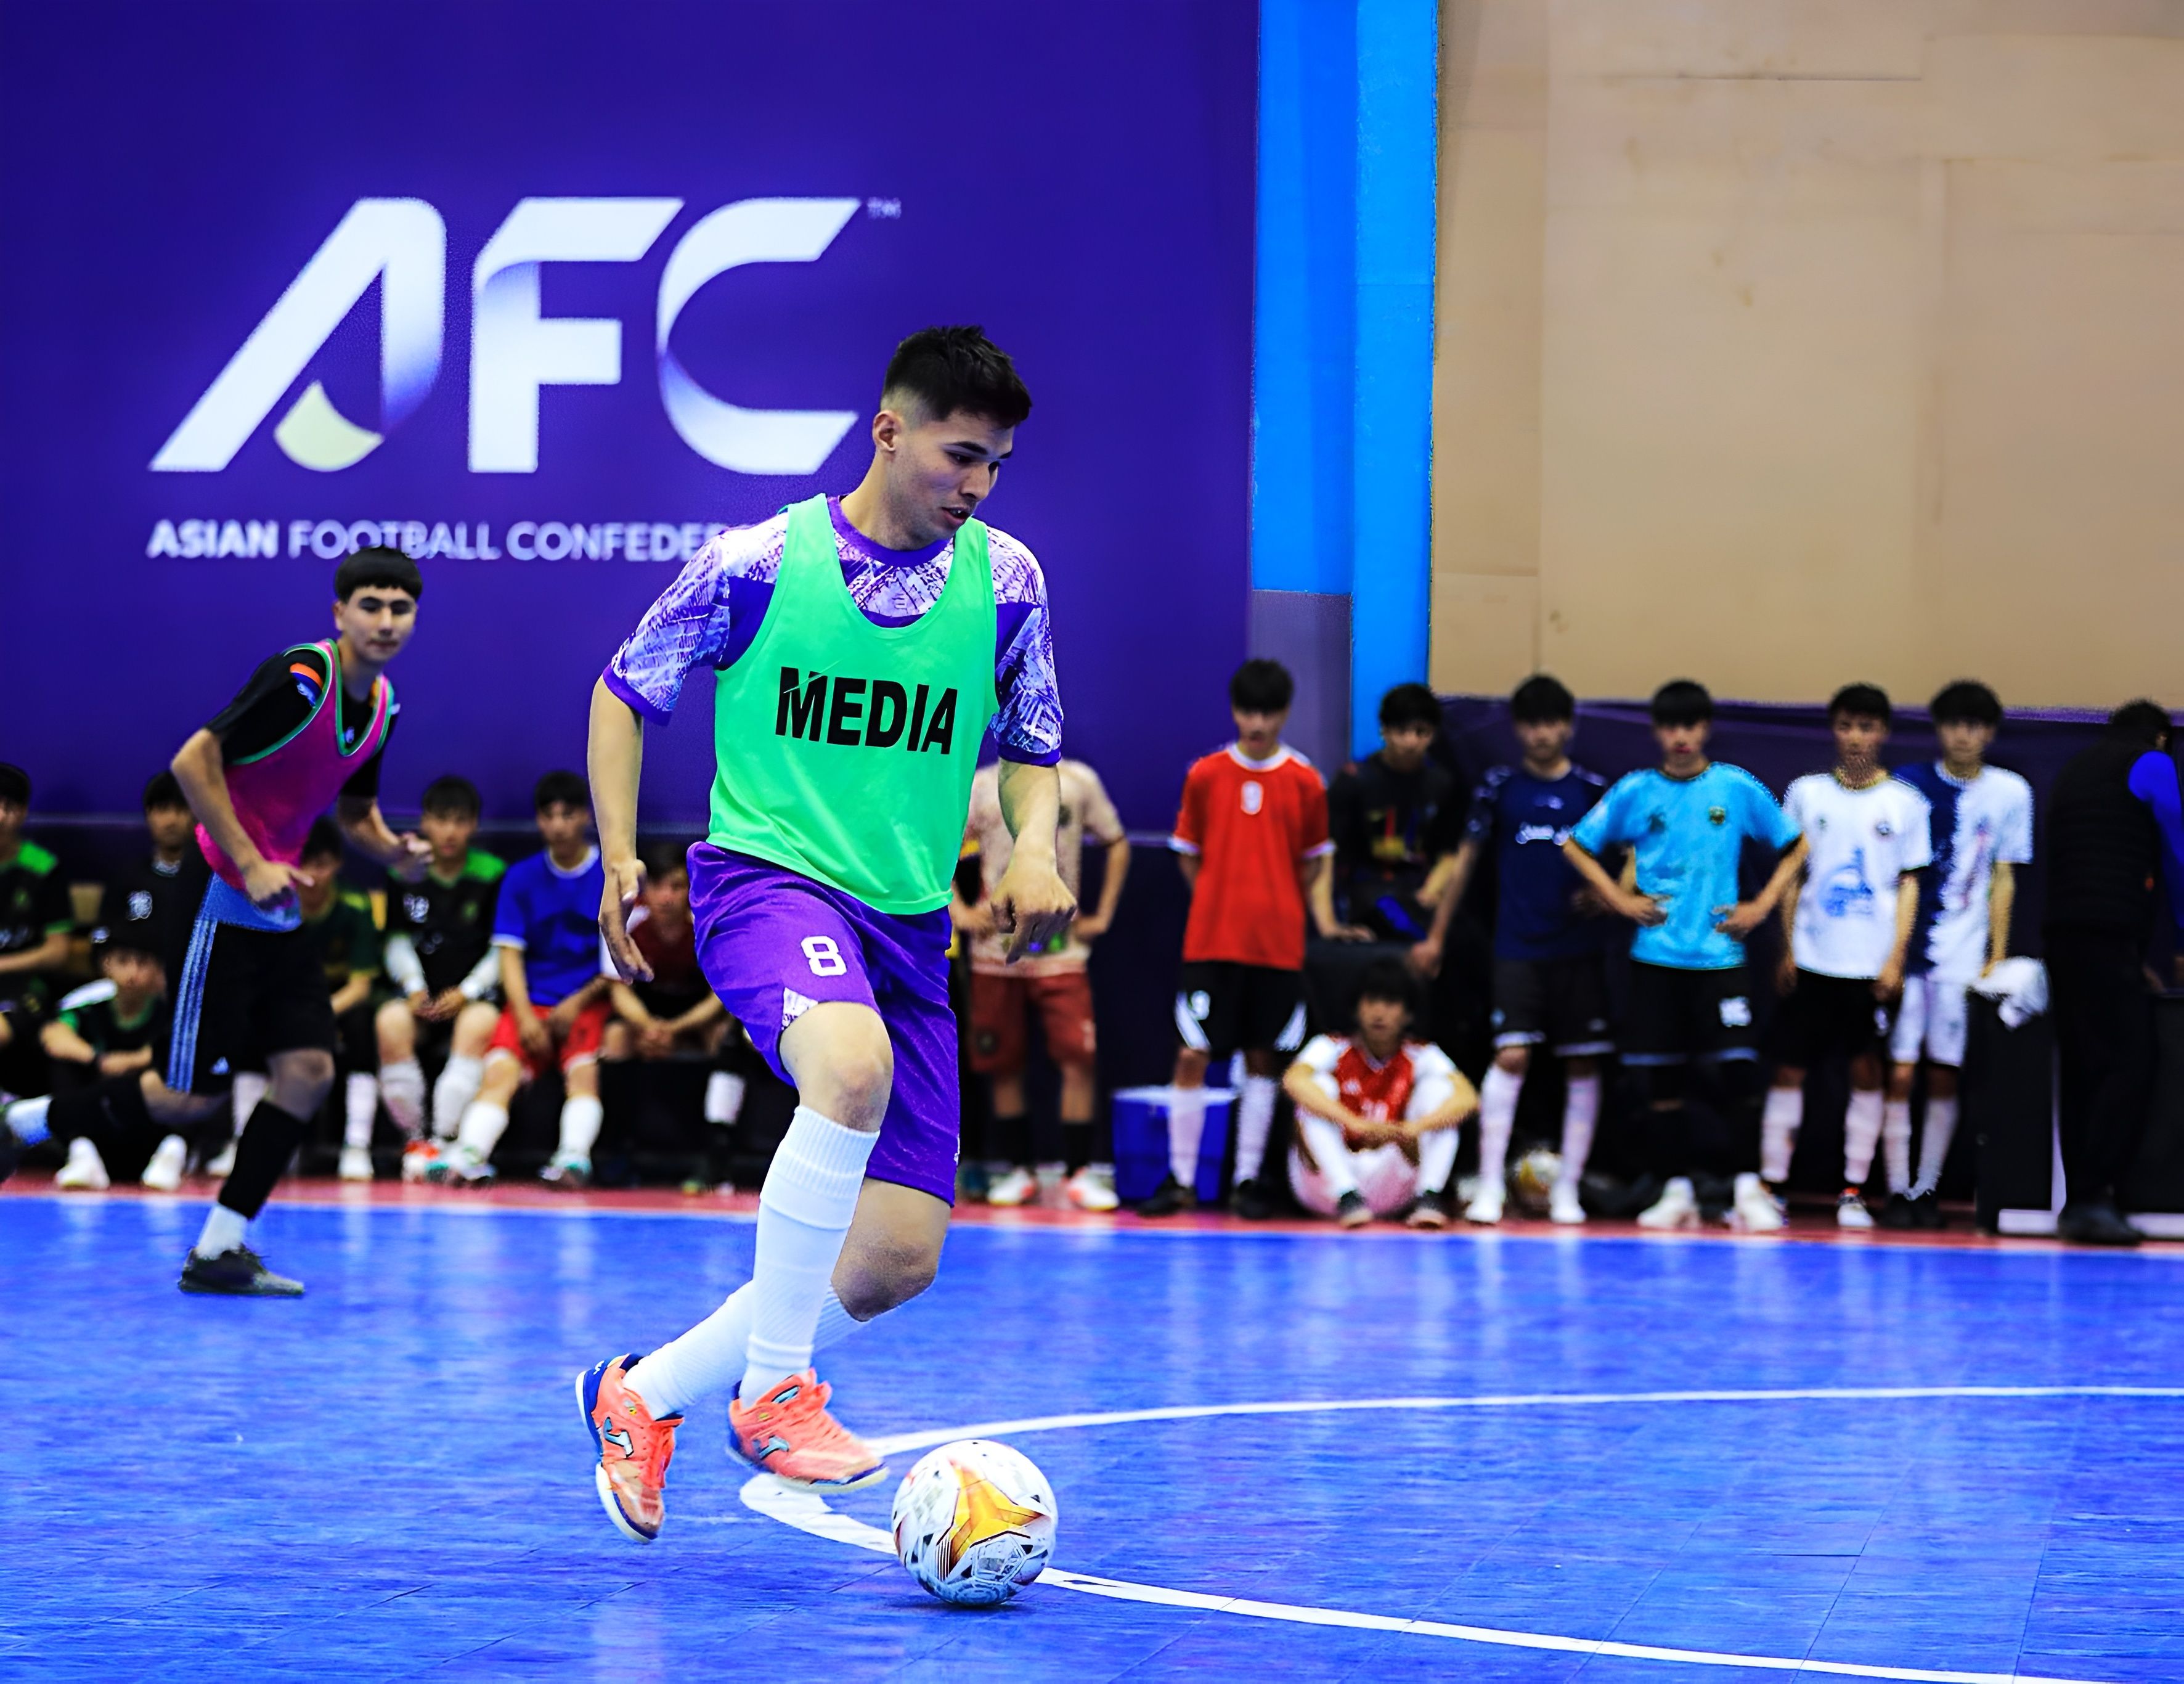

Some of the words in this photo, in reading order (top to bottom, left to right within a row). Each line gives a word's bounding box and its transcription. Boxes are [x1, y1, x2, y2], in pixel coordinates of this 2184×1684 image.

[148, 197, 861, 475] AFC
[146, 519, 279, 558] ASIAN
[287, 520, 502, 560] FOOTBALL
[775, 666, 958, 755] MEDIA
[801, 936, 847, 976] 8
